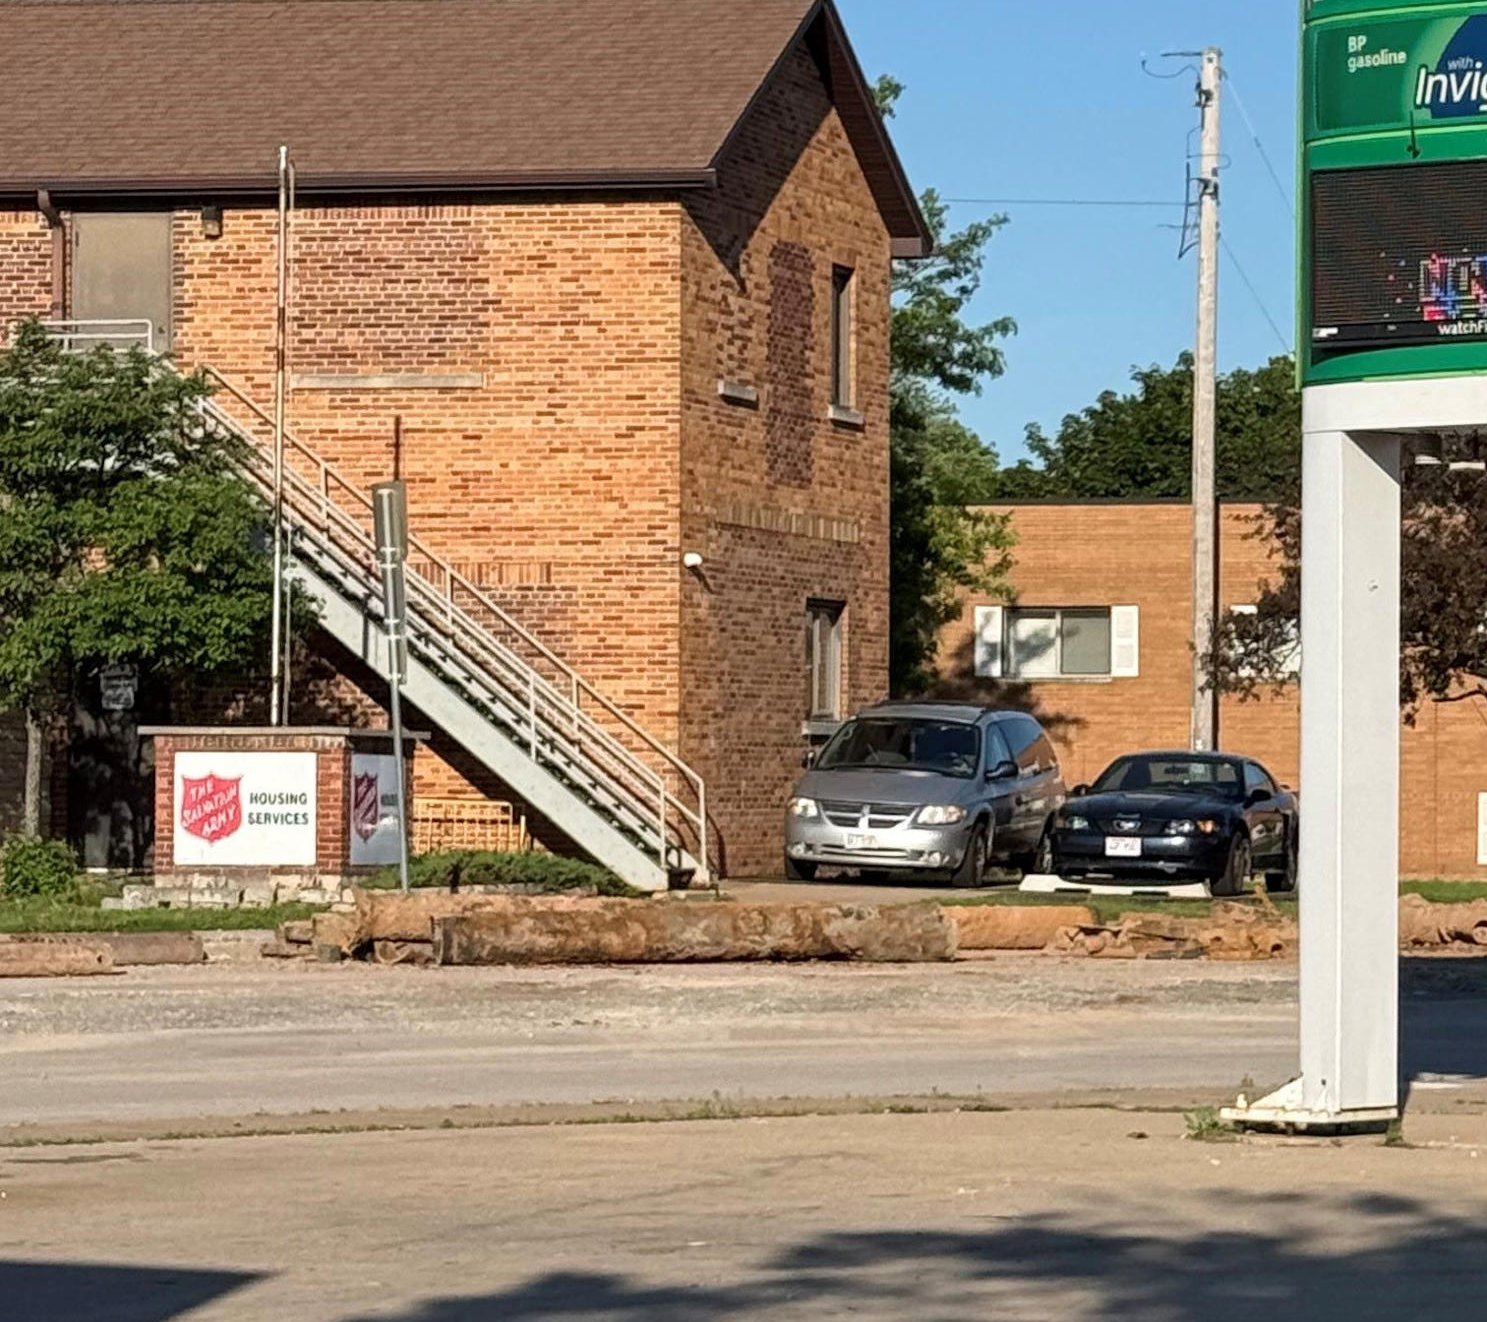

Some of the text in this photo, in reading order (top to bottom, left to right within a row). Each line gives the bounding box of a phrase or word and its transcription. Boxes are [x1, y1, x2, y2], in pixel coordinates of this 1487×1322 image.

[1348, 35, 1368, 53] BP
[1347, 50, 1407, 73] gasoline
[1447, 56, 1474, 71] with
[190, 780, 214, 802] THE
[249, 792, 308, 806] HOUSING
[201, 803, 237, 837] ARMY
[247, 811, 309, 826] SERVICES
